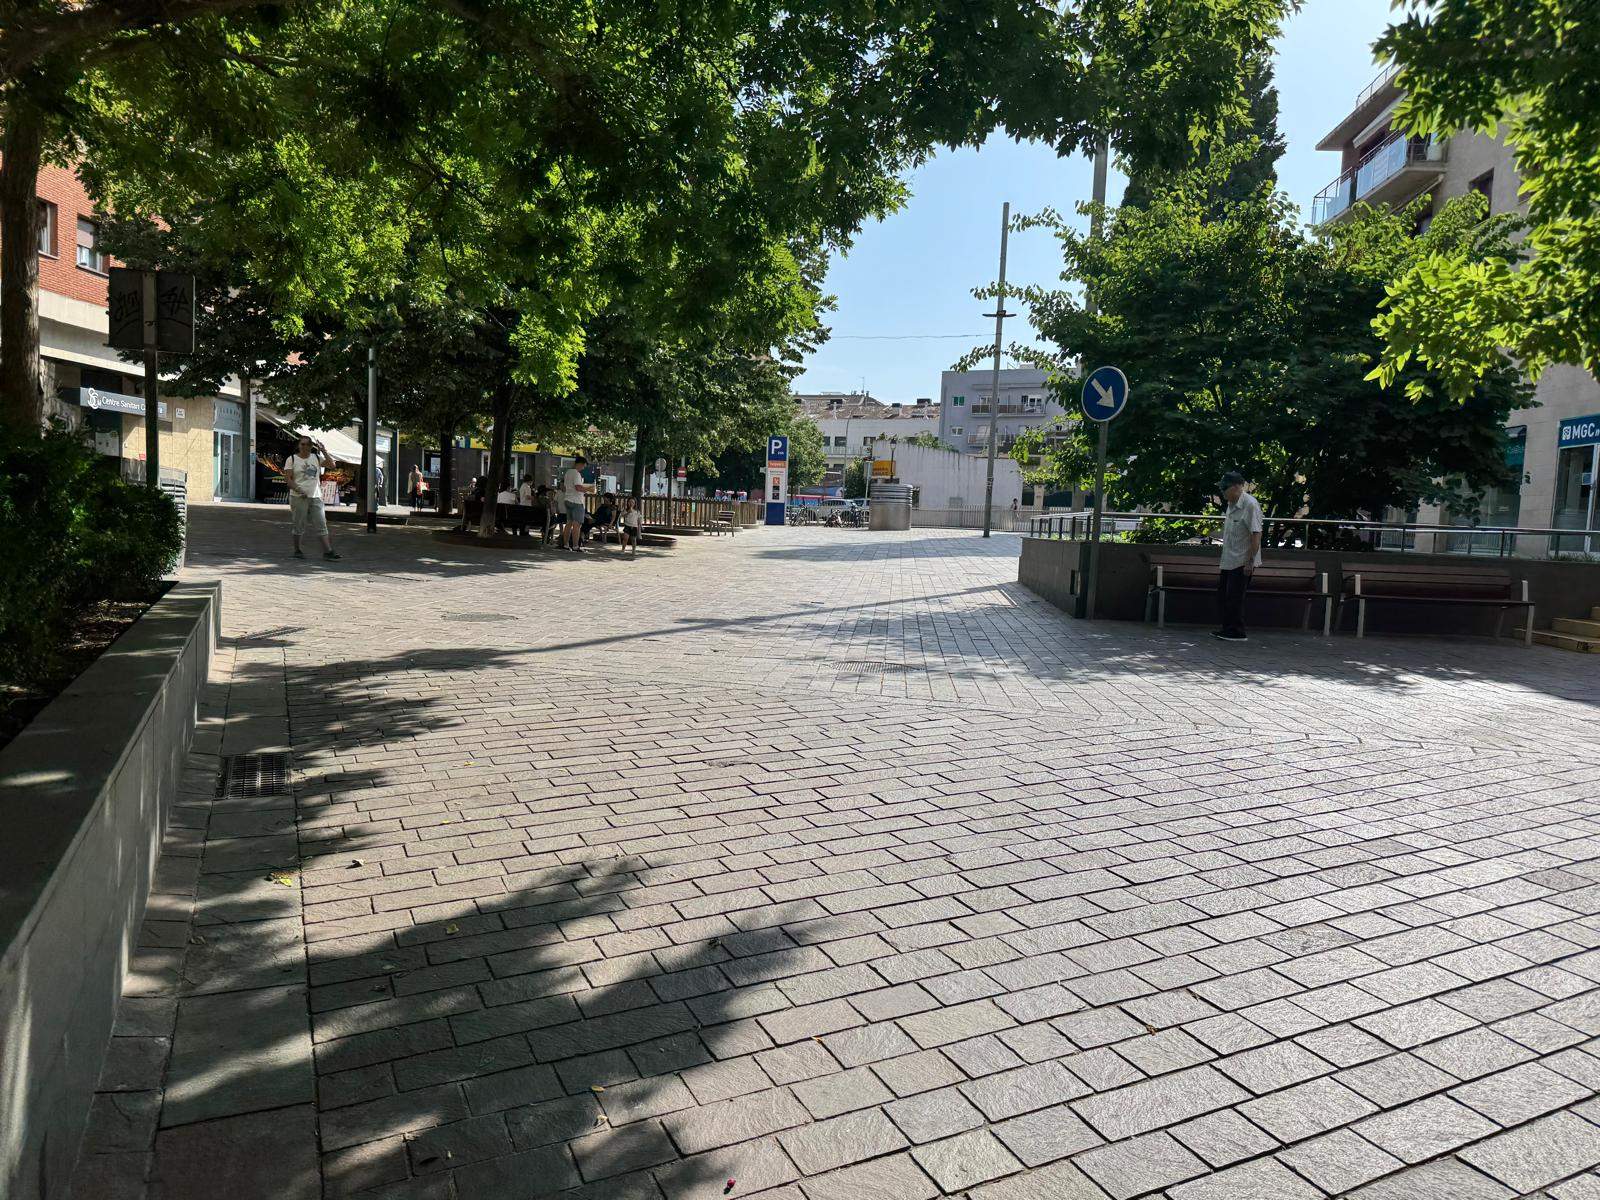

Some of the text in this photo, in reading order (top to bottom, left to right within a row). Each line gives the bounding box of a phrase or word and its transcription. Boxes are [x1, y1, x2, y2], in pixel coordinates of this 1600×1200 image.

[102, 396, 120, 406] Centre
[1572, 423, 1595, 439] MGC
[771, 439, 782, 454] P
